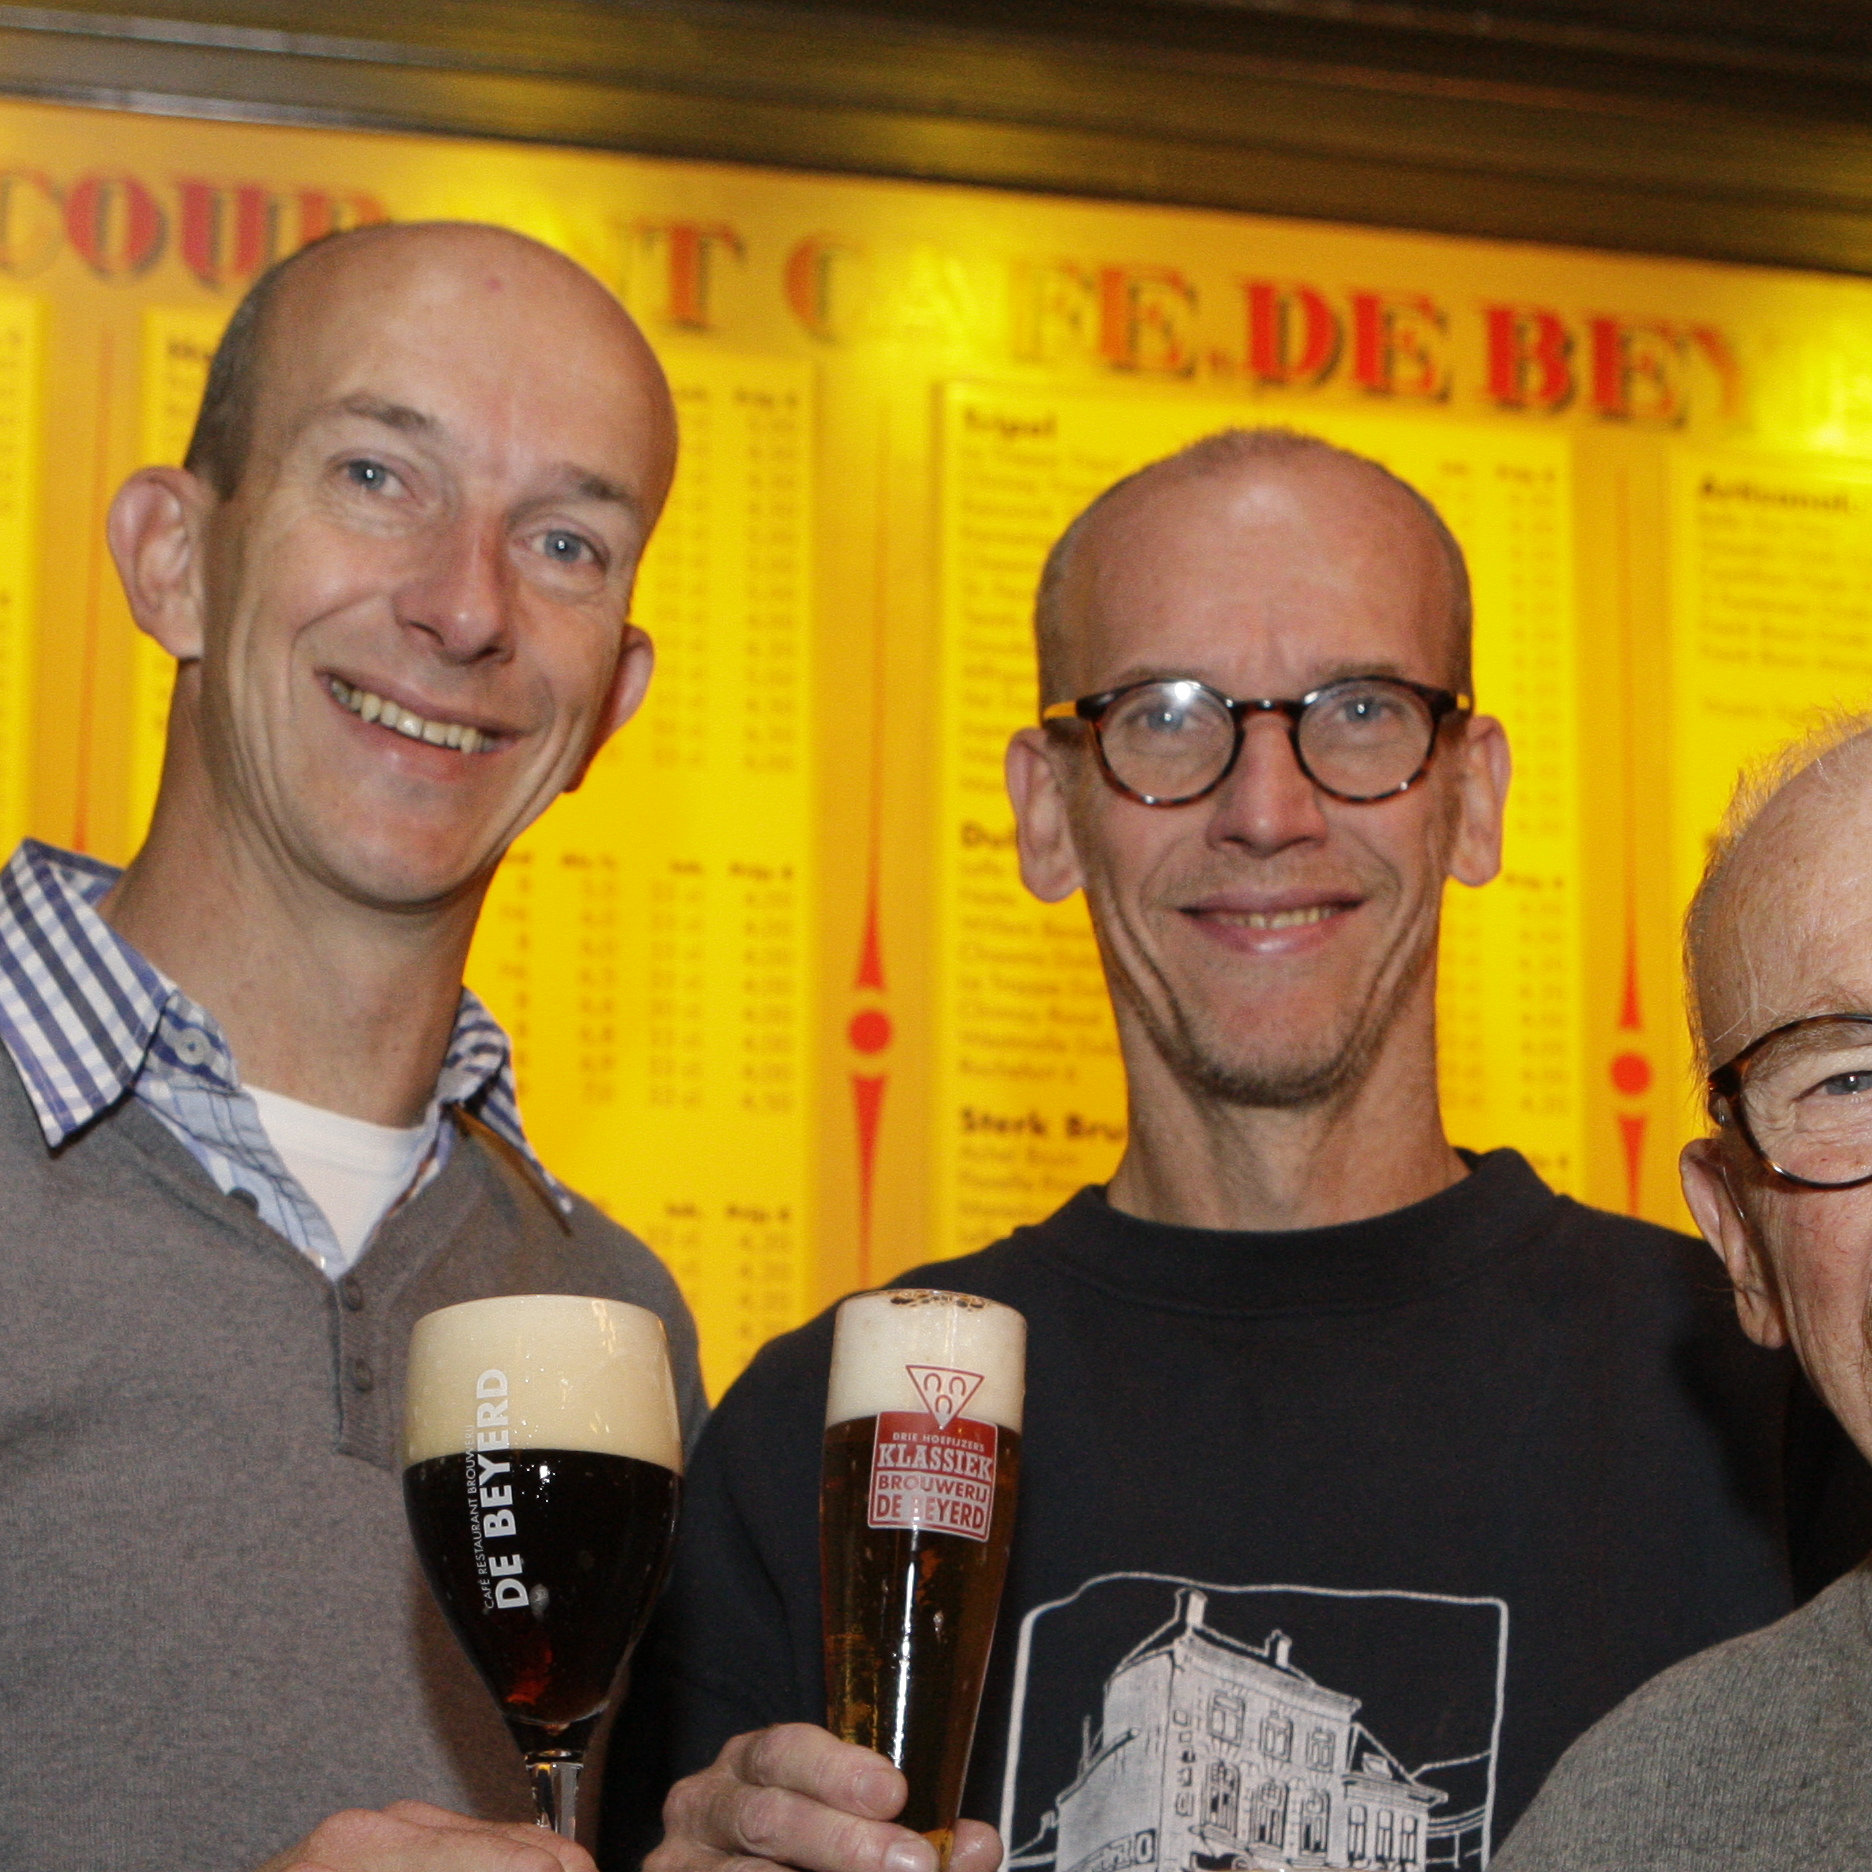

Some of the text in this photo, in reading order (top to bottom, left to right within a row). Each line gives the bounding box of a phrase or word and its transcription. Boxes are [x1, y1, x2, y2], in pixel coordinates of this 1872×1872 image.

[877, 1443, 993, 1483] KLASSIEK
[476, 1368, 530, 1609] DE BEYERD
[878, 1474, 987, 1504] BROUWERIJ
[876, 1494, 985, 1530] DE EYERD
[468, 1498, 488, 1575] RESTAURANT
